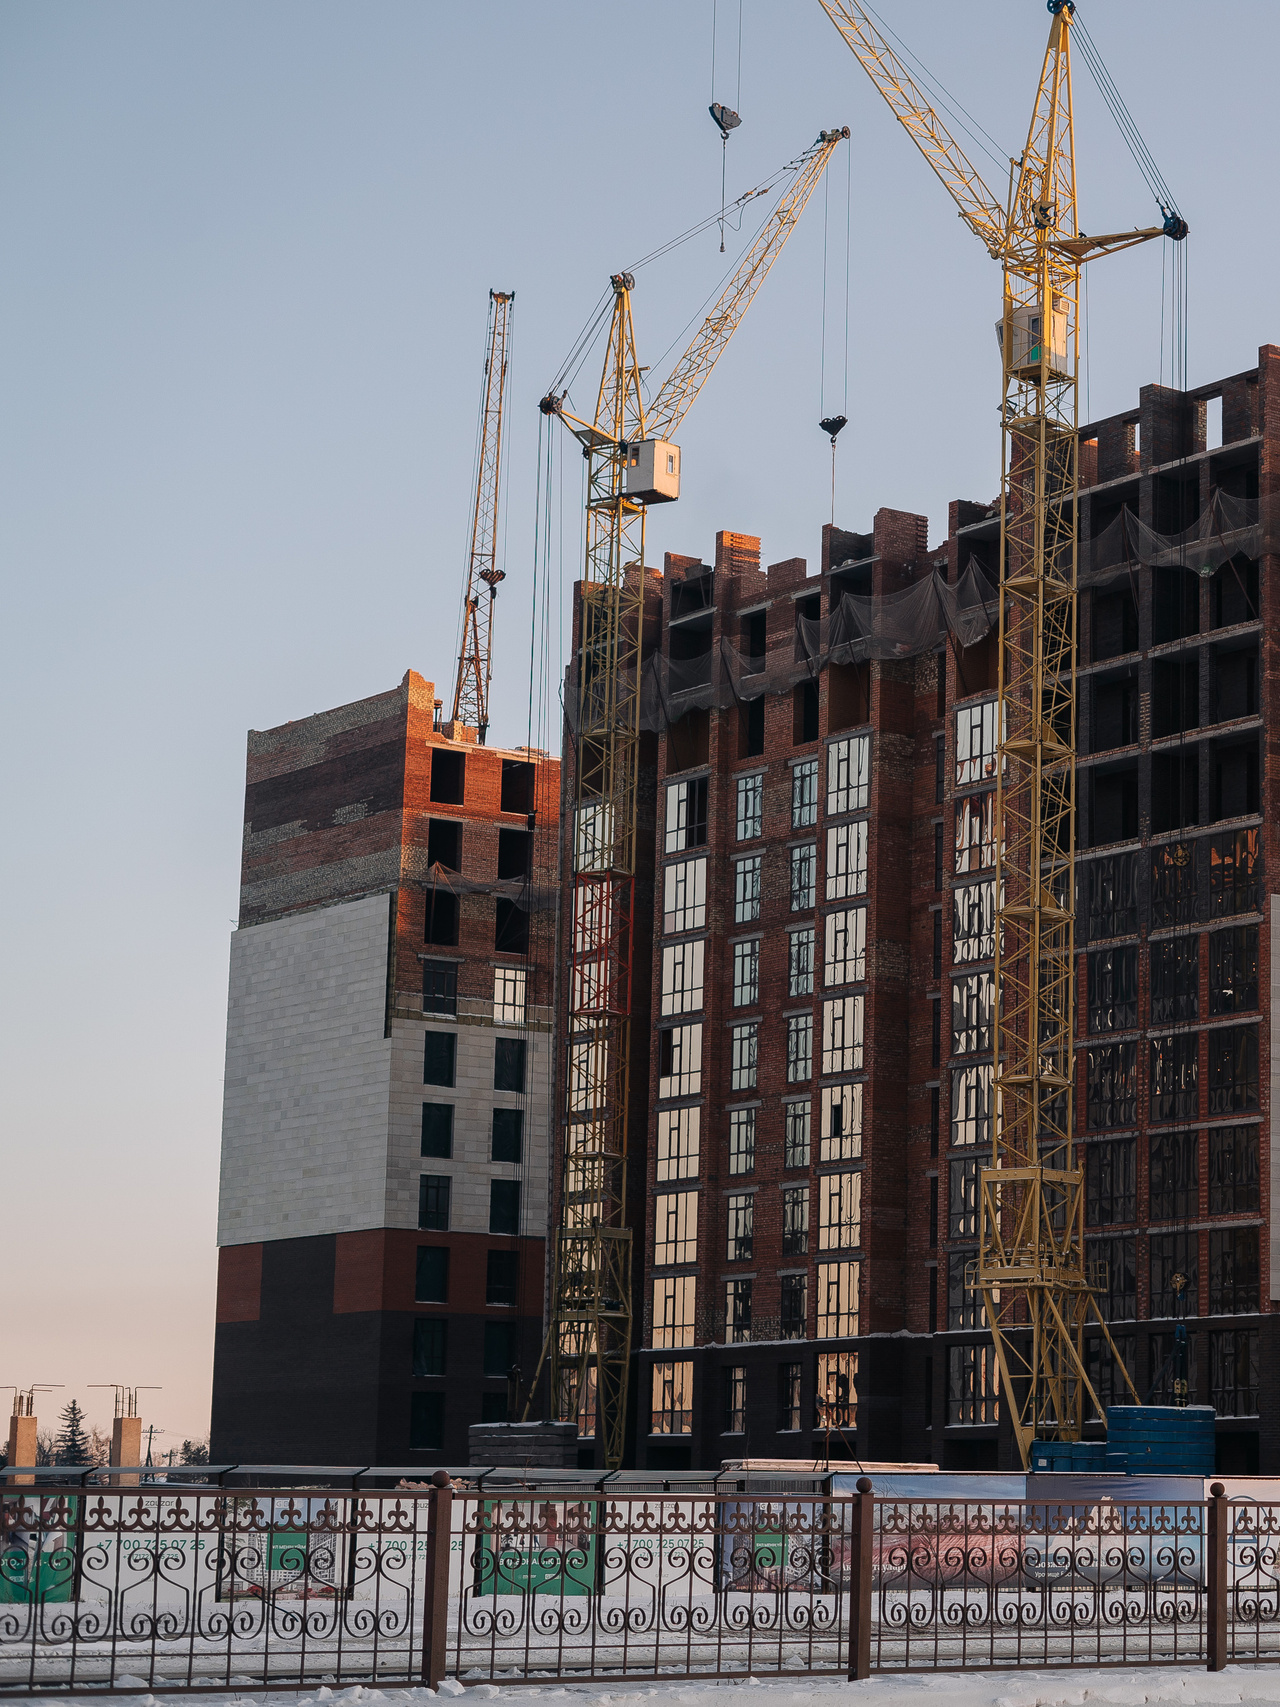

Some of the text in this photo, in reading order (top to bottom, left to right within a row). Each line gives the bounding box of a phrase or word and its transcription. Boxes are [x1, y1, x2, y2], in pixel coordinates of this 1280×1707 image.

[97, 1539, 113, 1550] +7
[144, 1539, 167, 1550] 725
[171, 1539, 186, 1550] 07
[190, 1539, 206, 1550] 25
[385, 1540, 407, 1551] 700
[616, 1539, 705, 1549] +7 700 725 07 25
